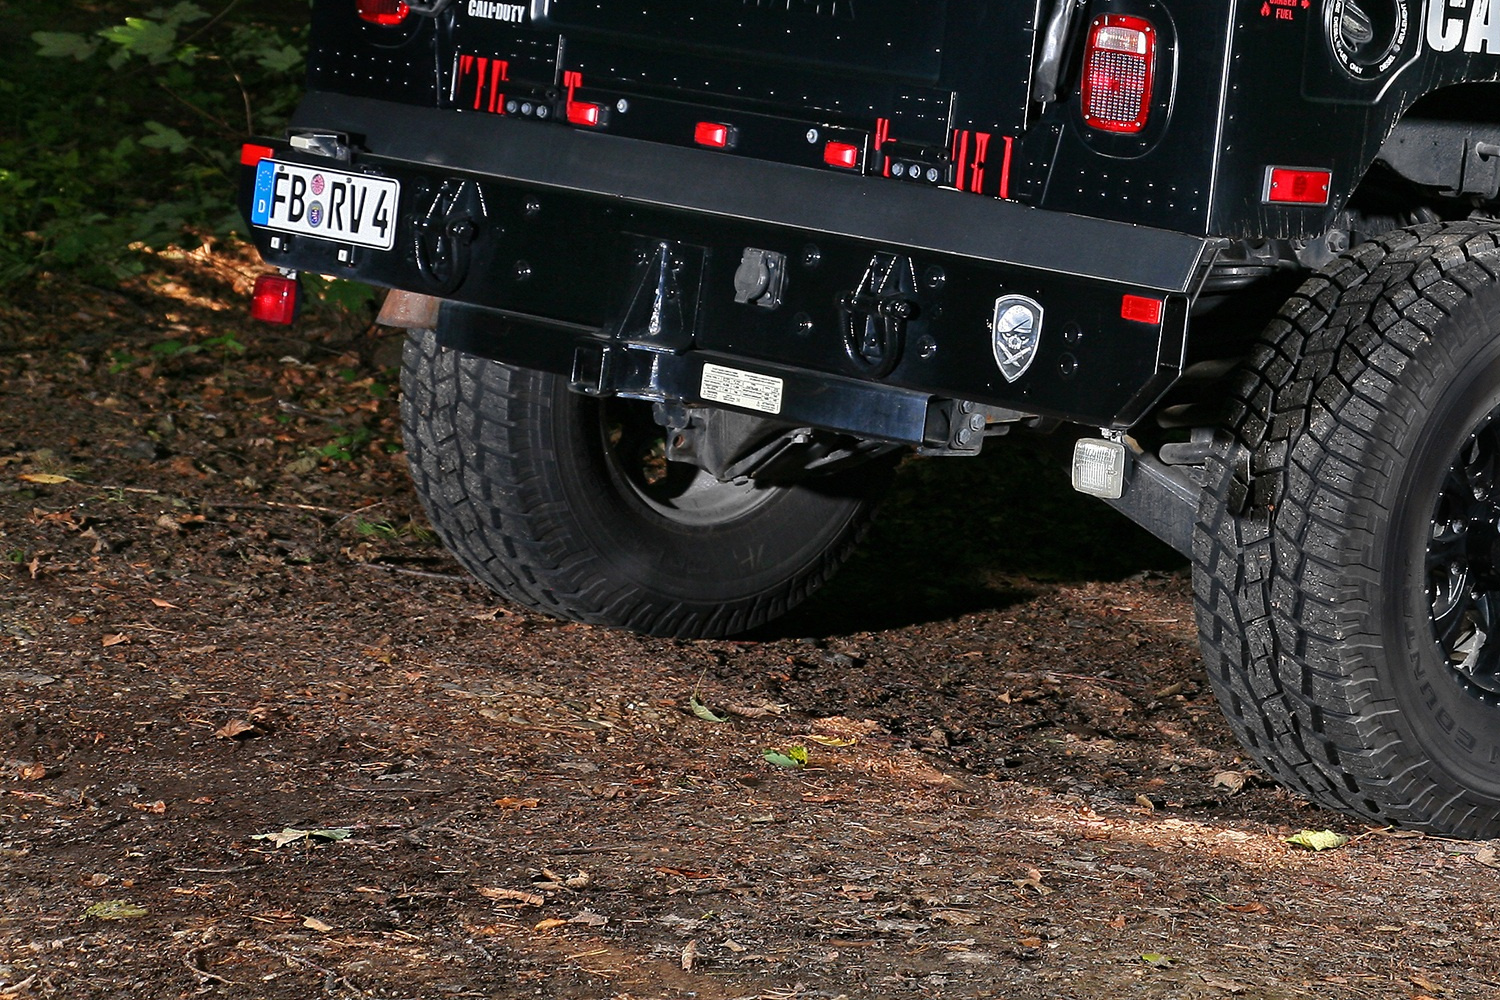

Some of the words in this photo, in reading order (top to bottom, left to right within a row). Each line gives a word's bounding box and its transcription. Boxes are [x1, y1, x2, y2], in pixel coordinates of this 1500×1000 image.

[467, 0, 494, 19] CALL
[495, 2, 526, 23] DUTY
[1276, 8, 1293, 20] FUEL
[258, 199, 266, 213] D
[270, 172, 306, 222] FB
